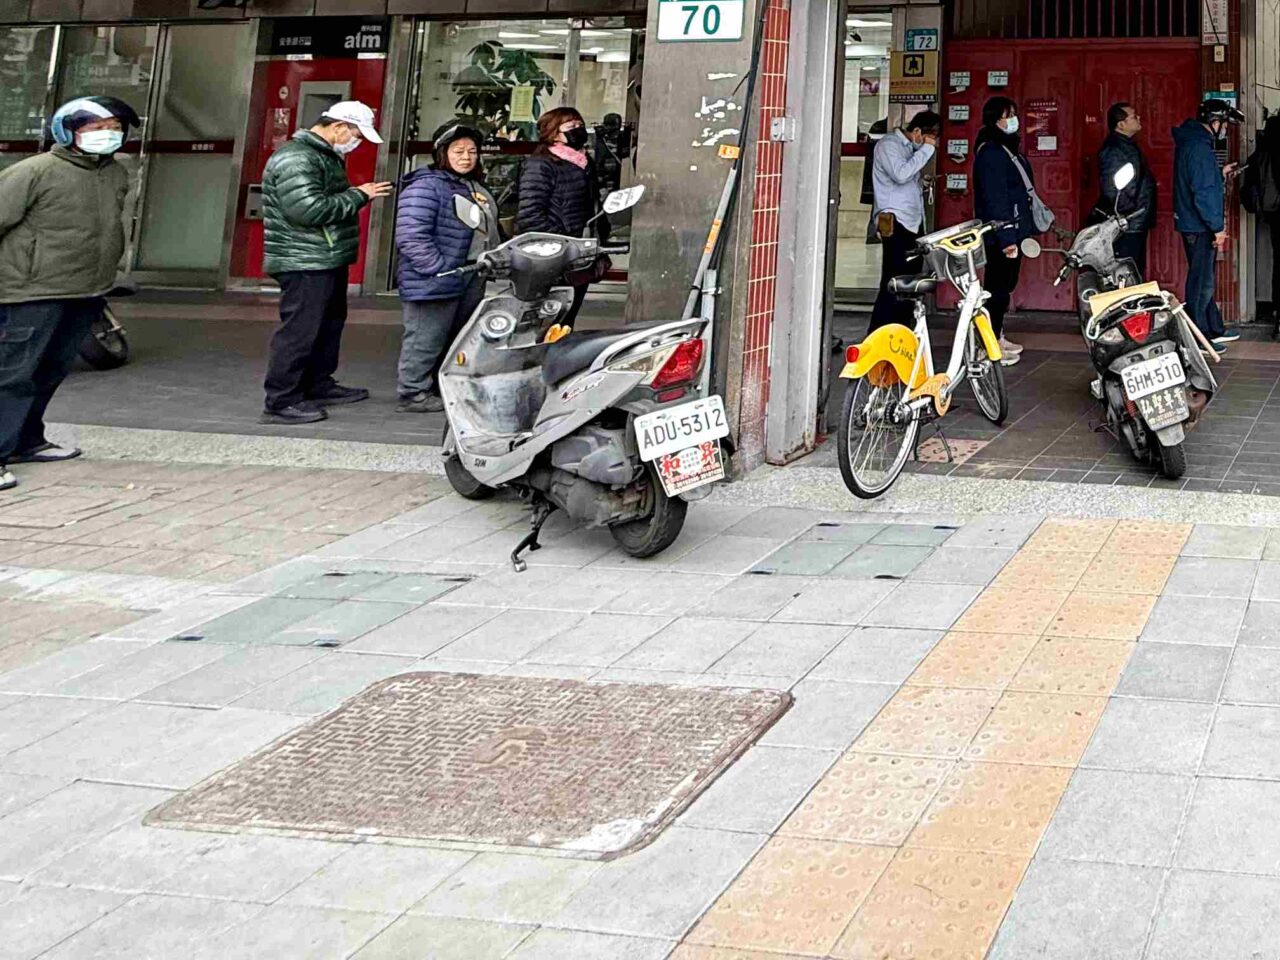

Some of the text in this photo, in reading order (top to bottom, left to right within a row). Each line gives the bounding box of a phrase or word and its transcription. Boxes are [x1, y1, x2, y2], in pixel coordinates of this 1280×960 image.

[681, 4, 721, 36] 70
[344, 31, 381, 49] atm
[919, 36, 933, 49] 72
[643, 408, 724, 449] ADU-5312
